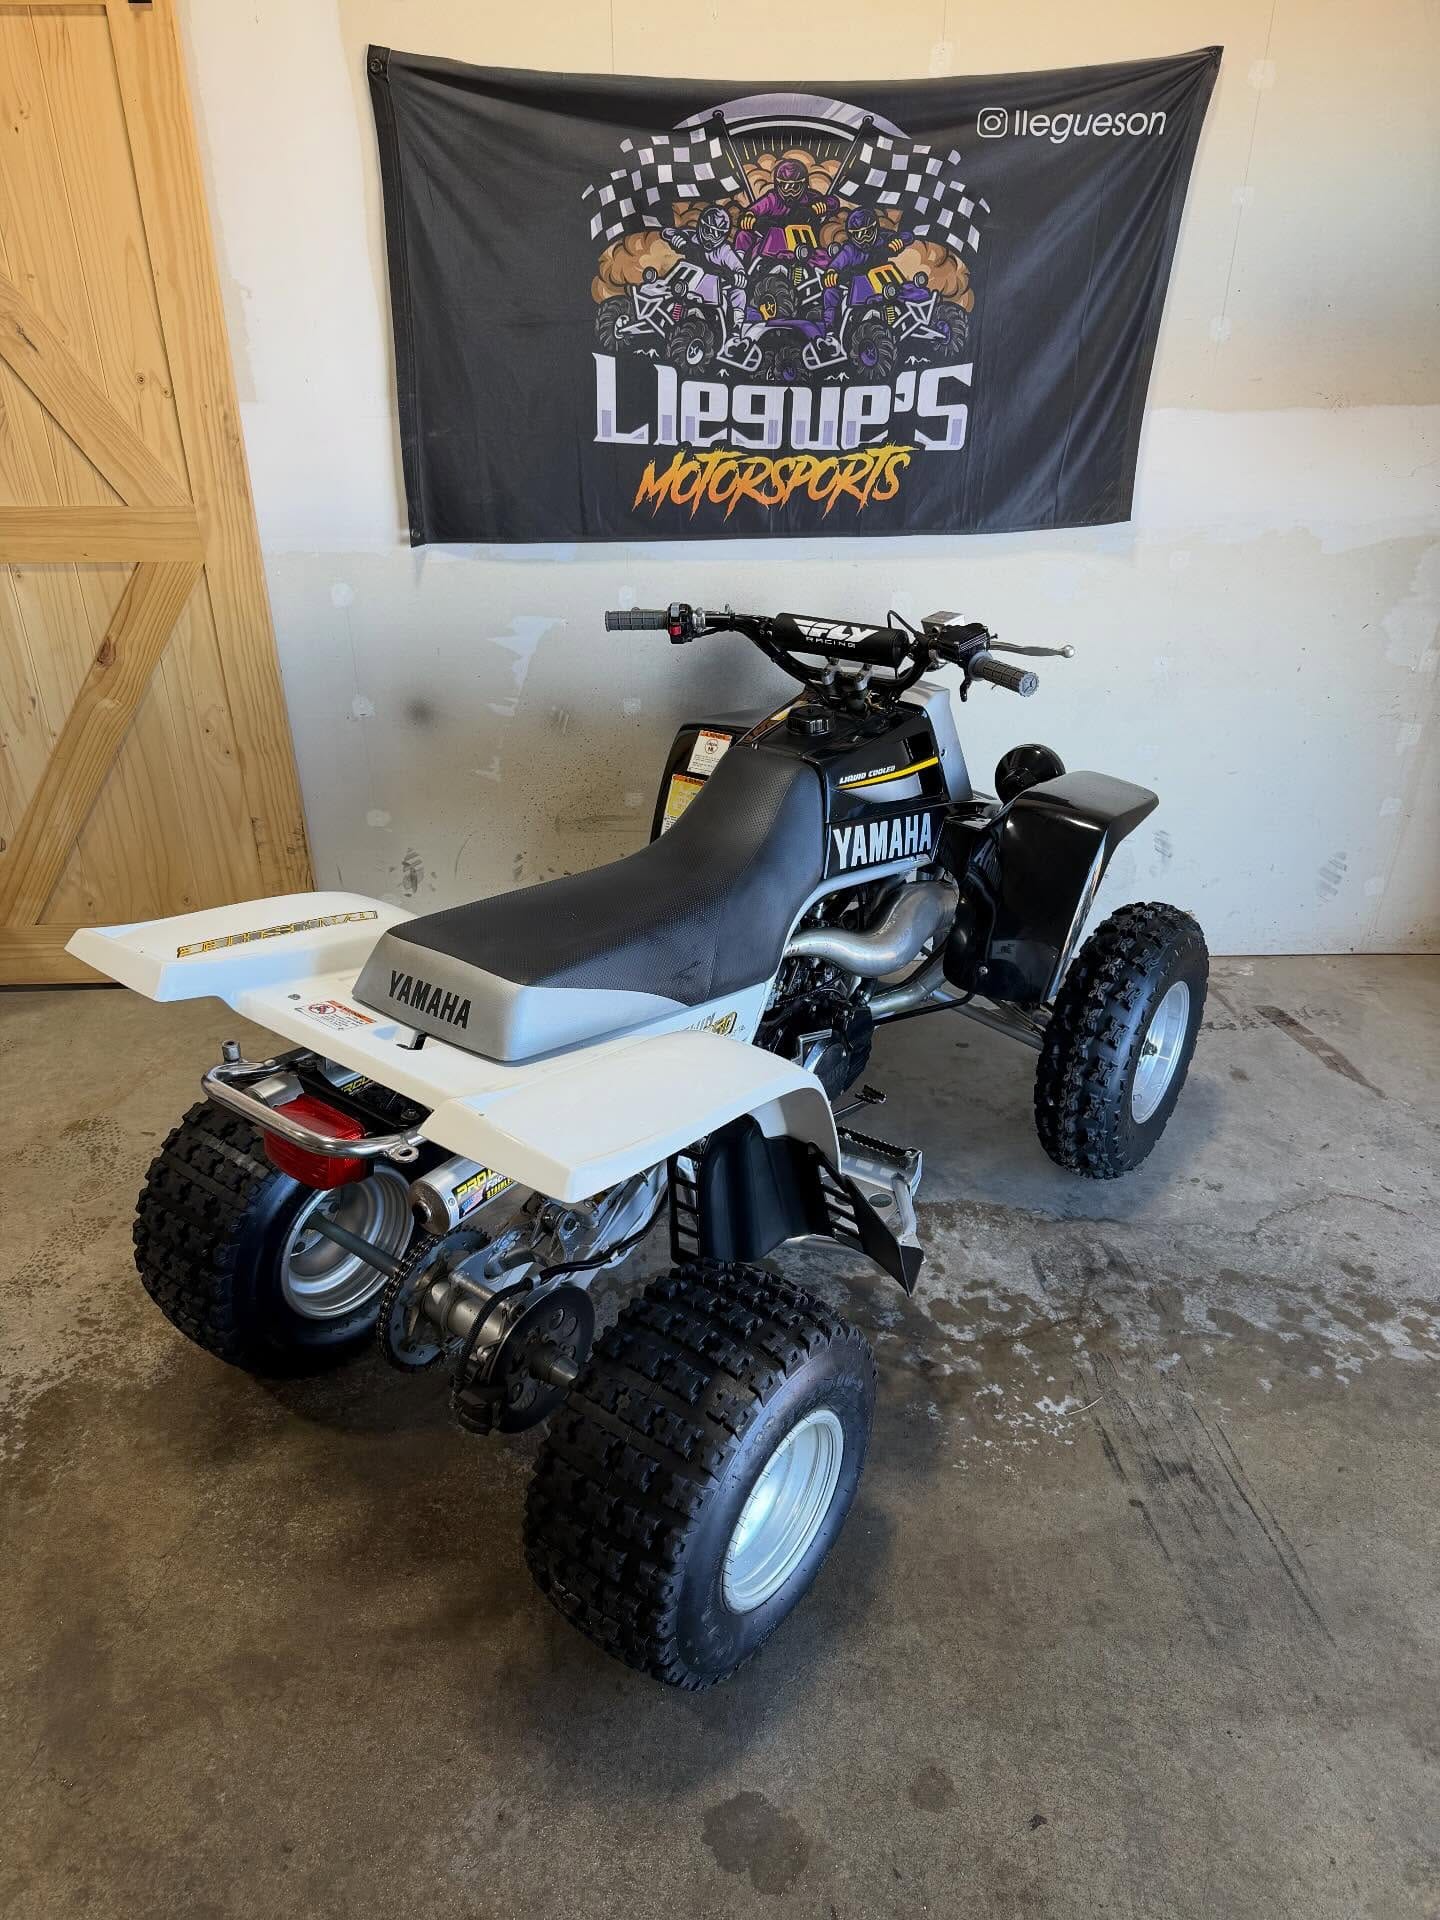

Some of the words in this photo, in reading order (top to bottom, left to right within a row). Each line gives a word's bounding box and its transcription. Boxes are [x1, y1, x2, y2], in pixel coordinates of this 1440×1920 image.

[1014, 109, 1167, 145] llegueson
[631, 440, 921, 528] MOTORSPORTS
[793, 618, 879, 643] FLY
[805, 636, 856, 649] RACING
[839, 771, 867, 784] LIQUID
[867, 765, 896, 779] COOLED
[832, 812, 932, 870] YAMAHA
[388, 969, 472, 1030] YAMAHA
